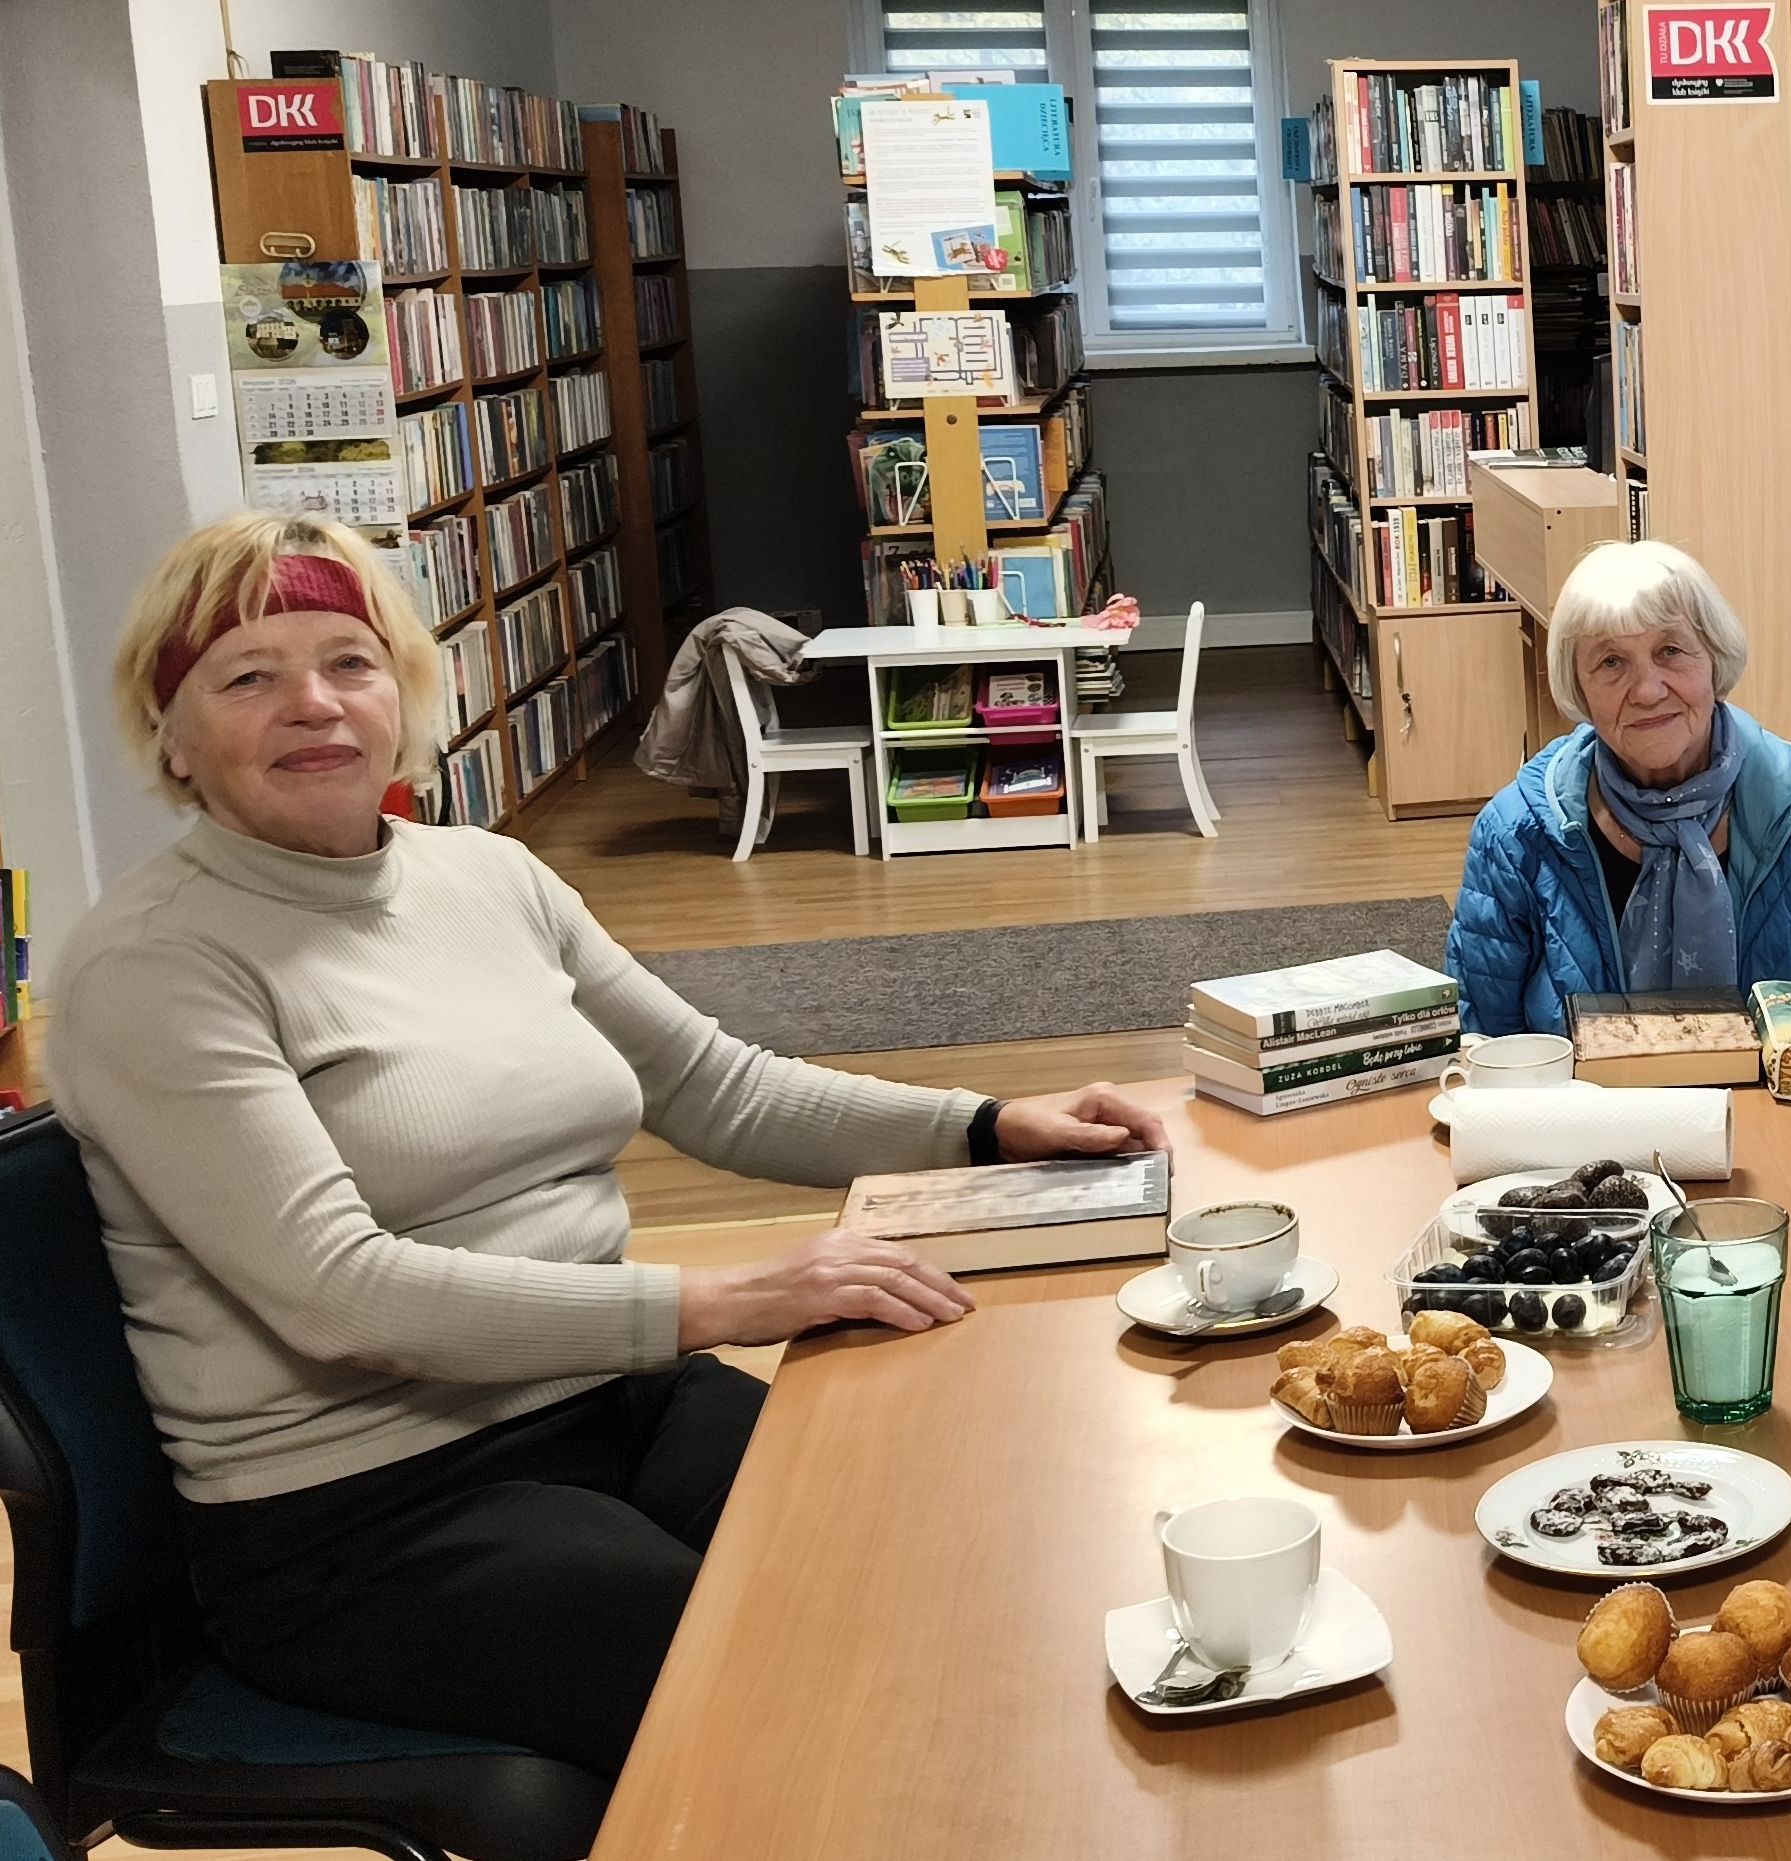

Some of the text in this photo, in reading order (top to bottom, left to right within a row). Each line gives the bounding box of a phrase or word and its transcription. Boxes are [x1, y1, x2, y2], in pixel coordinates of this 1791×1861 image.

[1262, 1005, 1456, 1049] Alistair MacLean Tylko dla orłów
[1278, 1071, 1303, 1083] ZUZA
[1306, 1062, 1342, 1076] KORDEL
[1345, 1066, 1417, 1095] Ogniste serca
